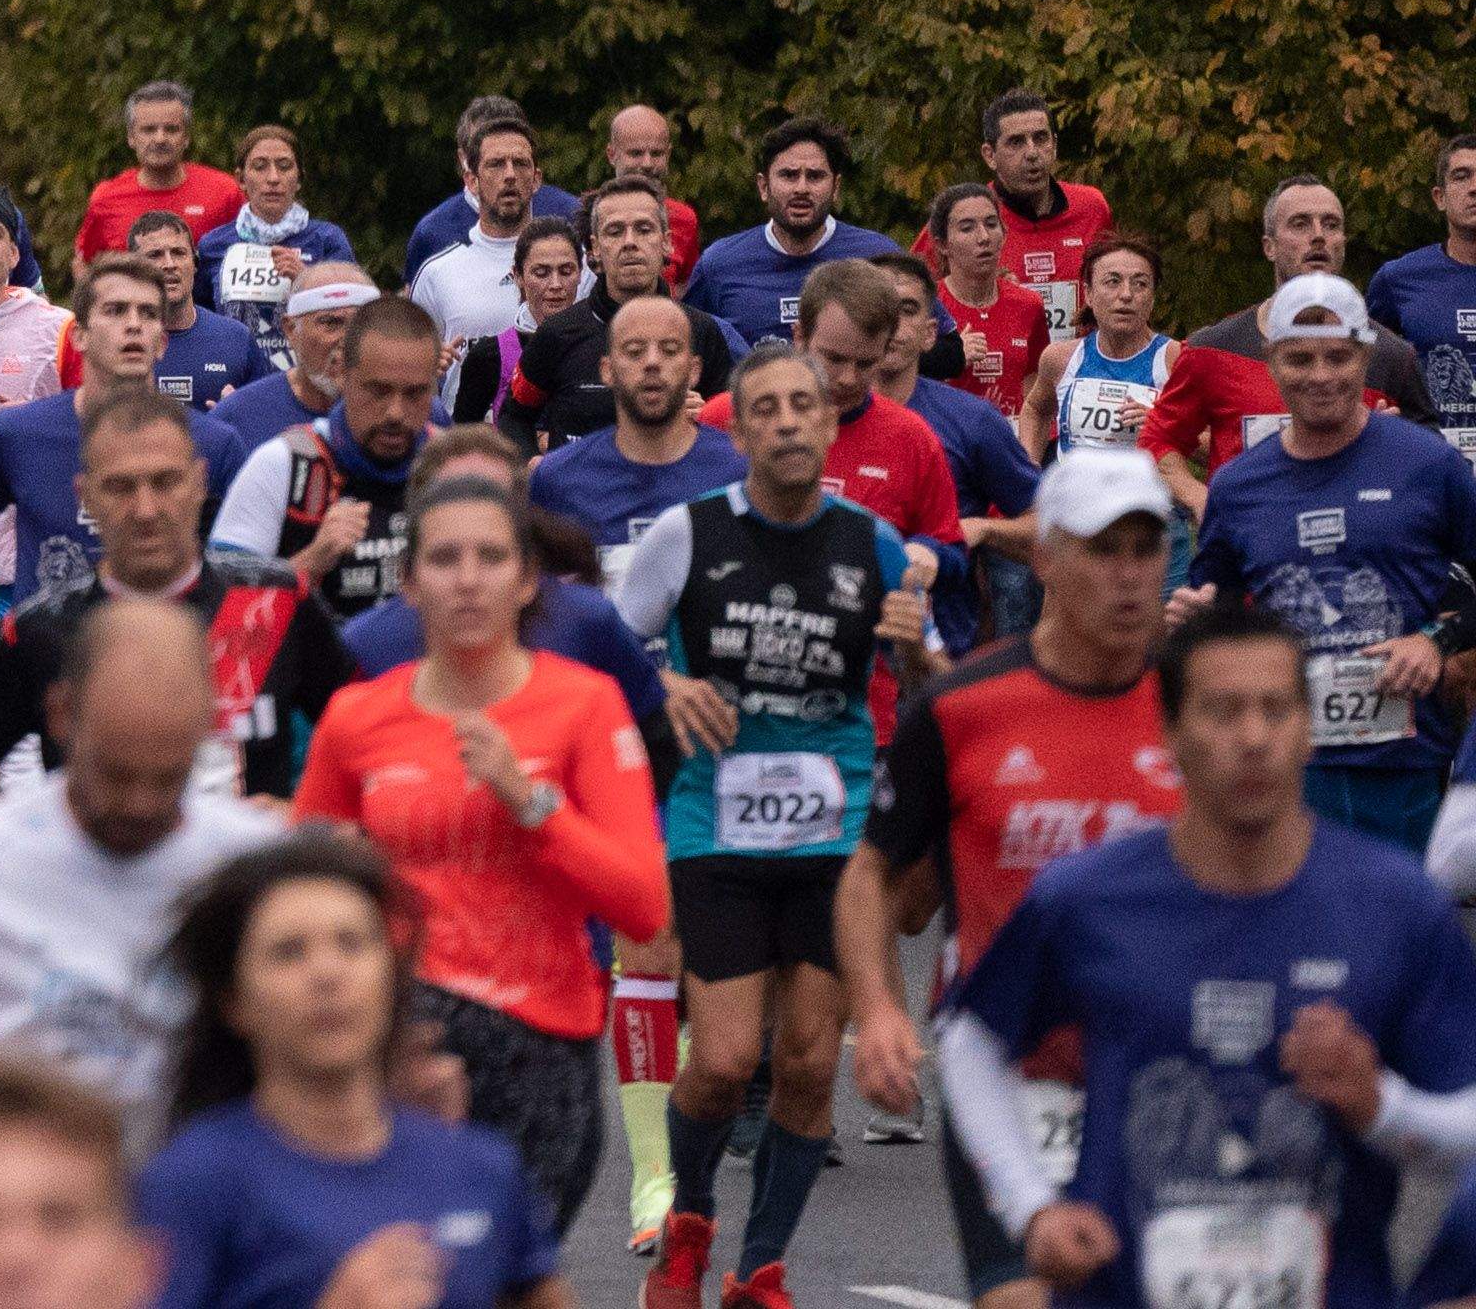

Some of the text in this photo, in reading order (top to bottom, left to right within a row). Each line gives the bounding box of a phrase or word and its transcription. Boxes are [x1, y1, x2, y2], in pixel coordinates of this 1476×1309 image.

[230, 267, 281, 288] 1458
[204, 363, 227, 372] HOKA
[354, 535, 409, 562] MAP
[725, 602, 836, 639] MAPFRE
[1325, 692, 1383, 722] 627
[735, 792, 826, 825] 2022
